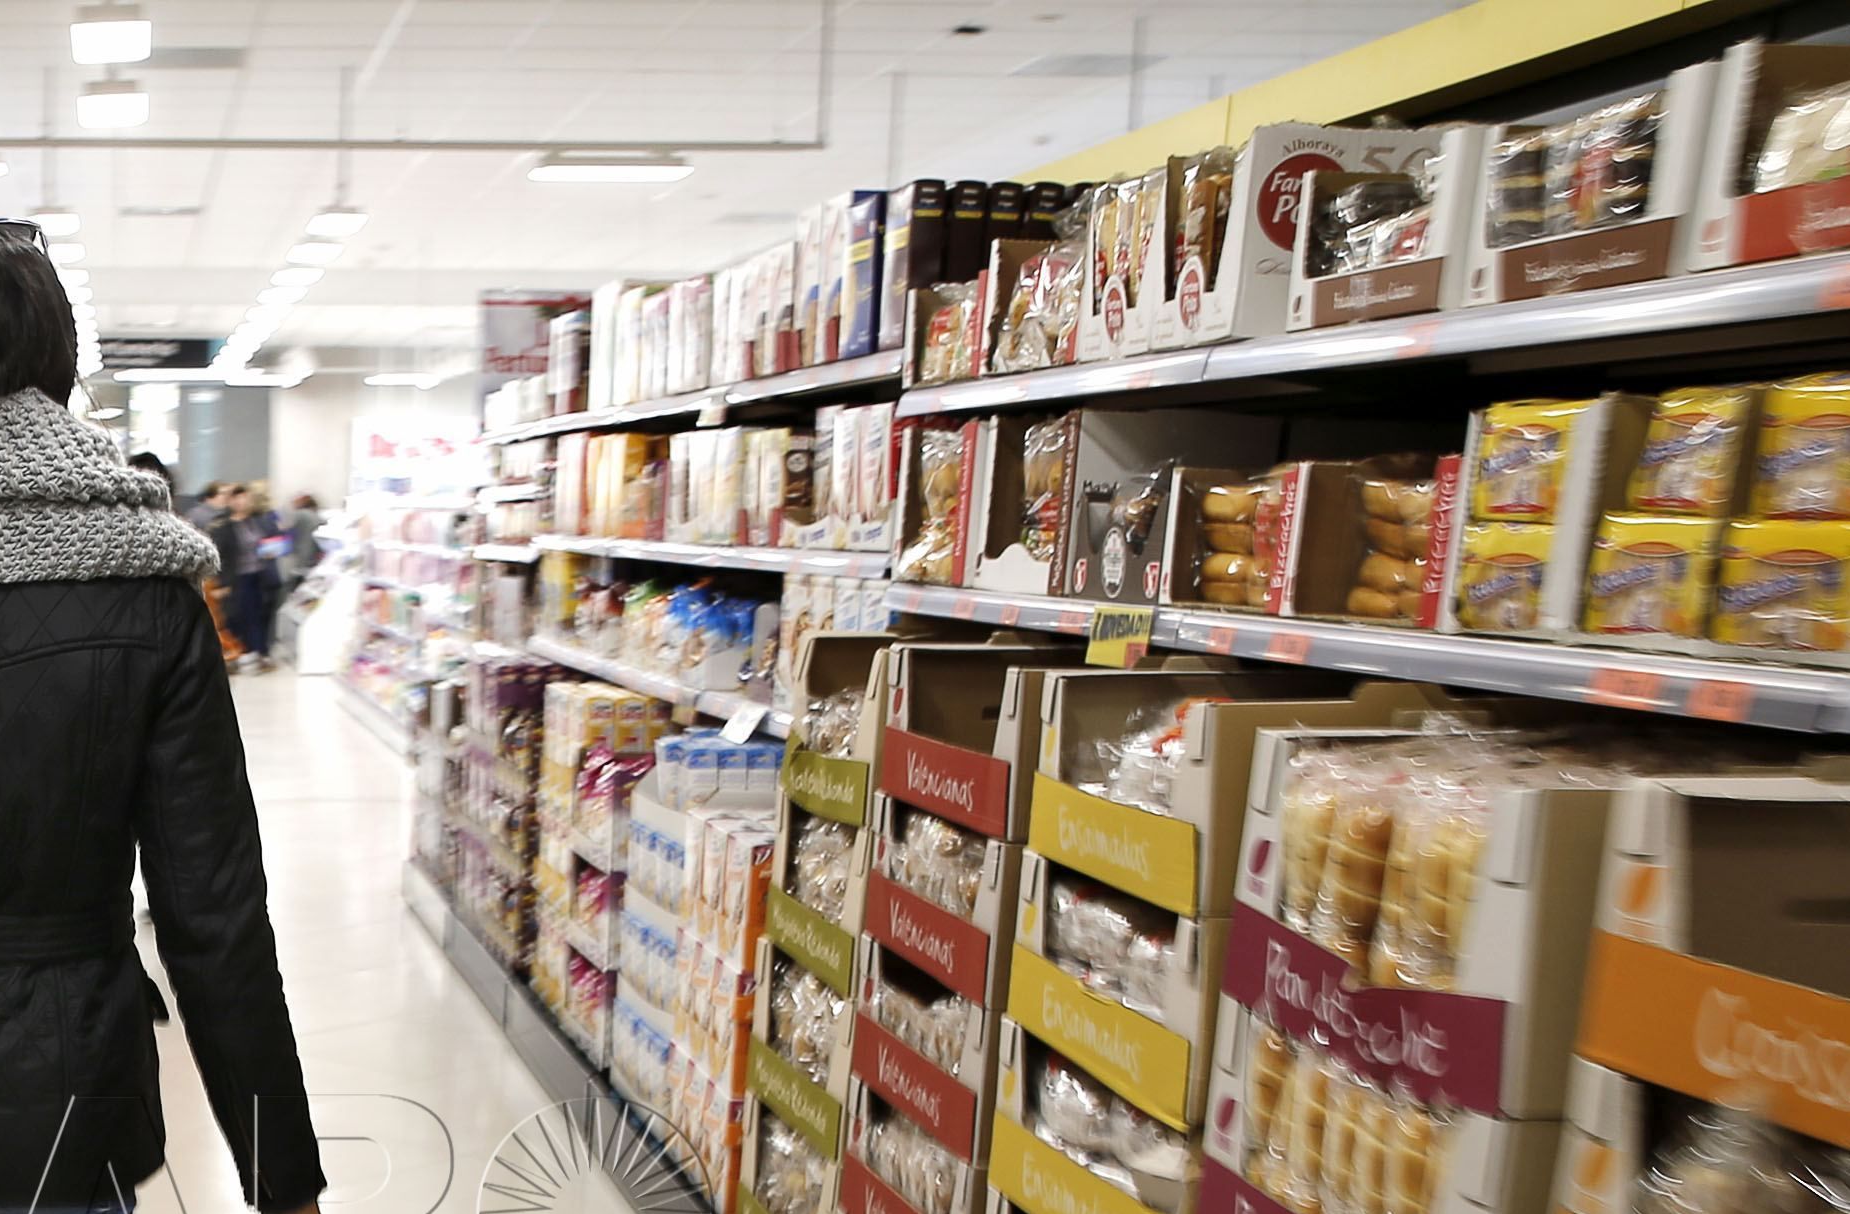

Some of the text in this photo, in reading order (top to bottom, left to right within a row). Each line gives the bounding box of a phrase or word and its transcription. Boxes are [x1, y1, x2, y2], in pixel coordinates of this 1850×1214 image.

[1282, 138, 1345, 158] Alboraya
[907, 750, 975, 812] Valencianas
[890, 897, 957, 974] Valencianas
[878, 1045, 941, 1128] Valencianas
